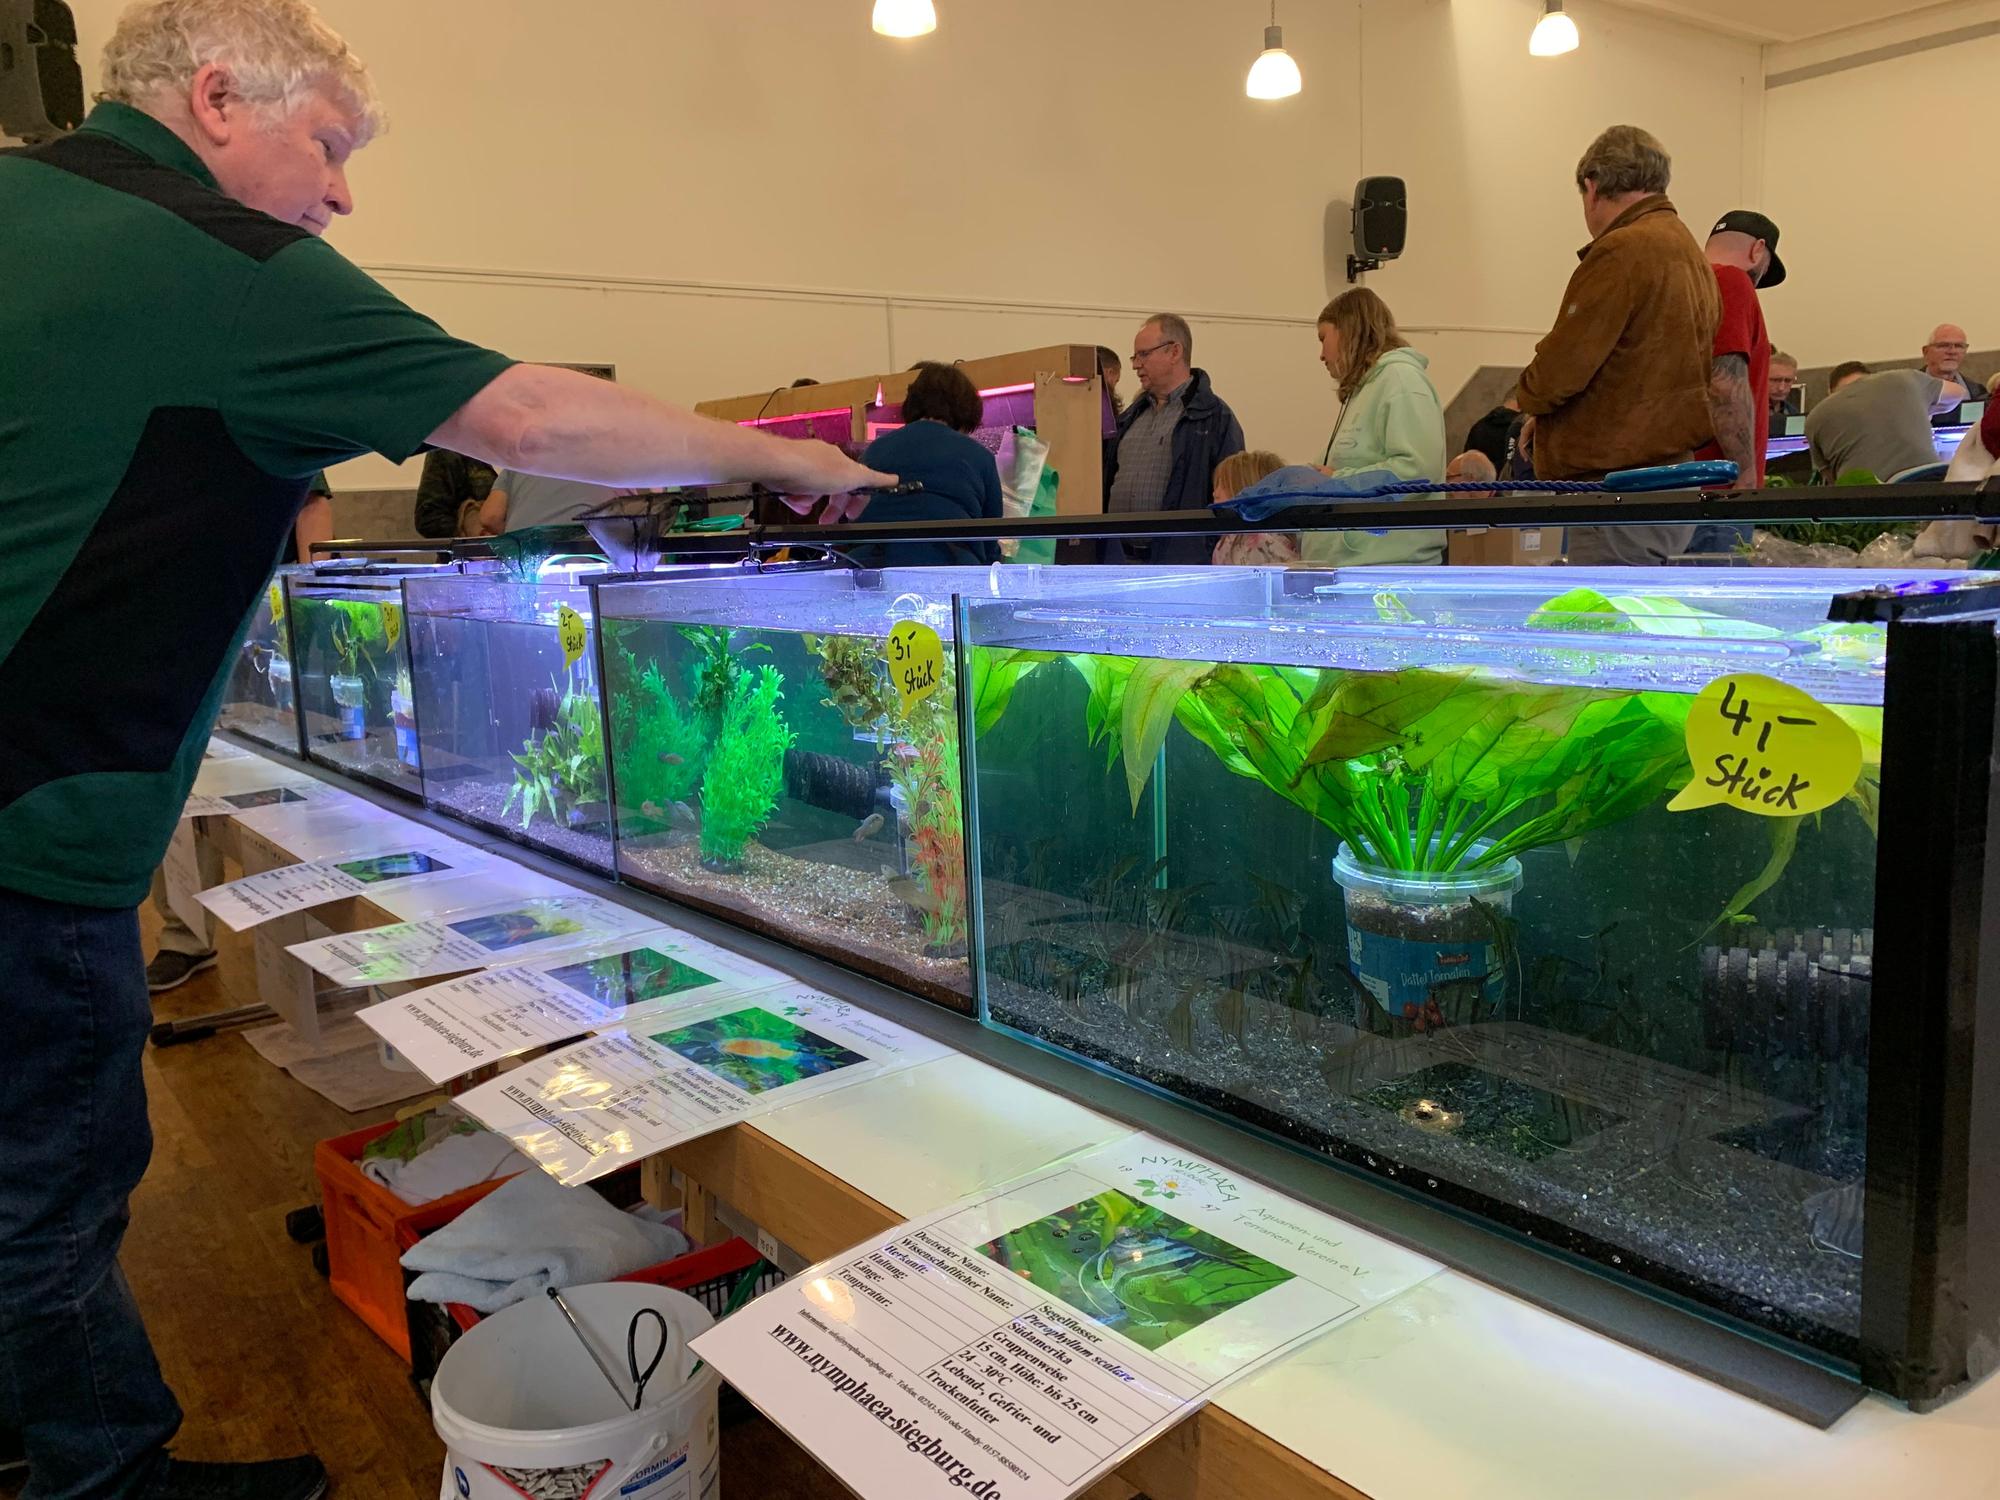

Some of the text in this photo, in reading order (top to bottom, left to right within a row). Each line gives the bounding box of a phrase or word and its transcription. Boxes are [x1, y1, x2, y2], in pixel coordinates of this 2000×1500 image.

[904, 660, 935, 695] Stück
[1706, 754, 1810, 810] Stück
[1400, 966, 1471, 987] Dattel Tomaten
[1141, 1156, 1240, 1202] NYMPHAEA
[884, 1245, 929, 1275] Herkunft:
[914, 1231, 990, 1279] Deutscher Name:
[1296, 1241, 1339, 1268] Verein
[1313, 1231, 1343, 1248] und
[838, 1268, 893, 1307] Temperatur:
[853, 1260, 885, 1283] Länge:
[868, 1253, 909, 1280] Haltung:
[901, 1238, 1014, 1309] Wissenschaftlicher Name:
[1007, 1320, 1074, 1365] Südamerika
[1038, 1303, 1103, 1344] Segelflosser
[957, 1349, 971, 1363] 24
[981, 1365, 1014, 1388] 30°C
[992, 1330, 1068, 1383] Gruppenweise
[1023, 1312, 1136, 1383] Pterophyllum scalare
[925, 1369, 1000, 1425] Trockenfutter
[941, 1358, 1062, 1445] Lebend-, Gefrier- und
[975, 1340, 989, 1352] 15
[1012, 1361, 1042, 1390] Höhe:
[1043, 1384, 1063, 1402] bis
[1061, 1396, 1079, 1413] 25
[1077, 1407, 1100, 1426] cm
[768, 1323, 1002, 1500] www.nymphaea-siegburg.de
[948, 1419, 964, 1432] oder
[961, 1427, 984, 1447] Handy:
